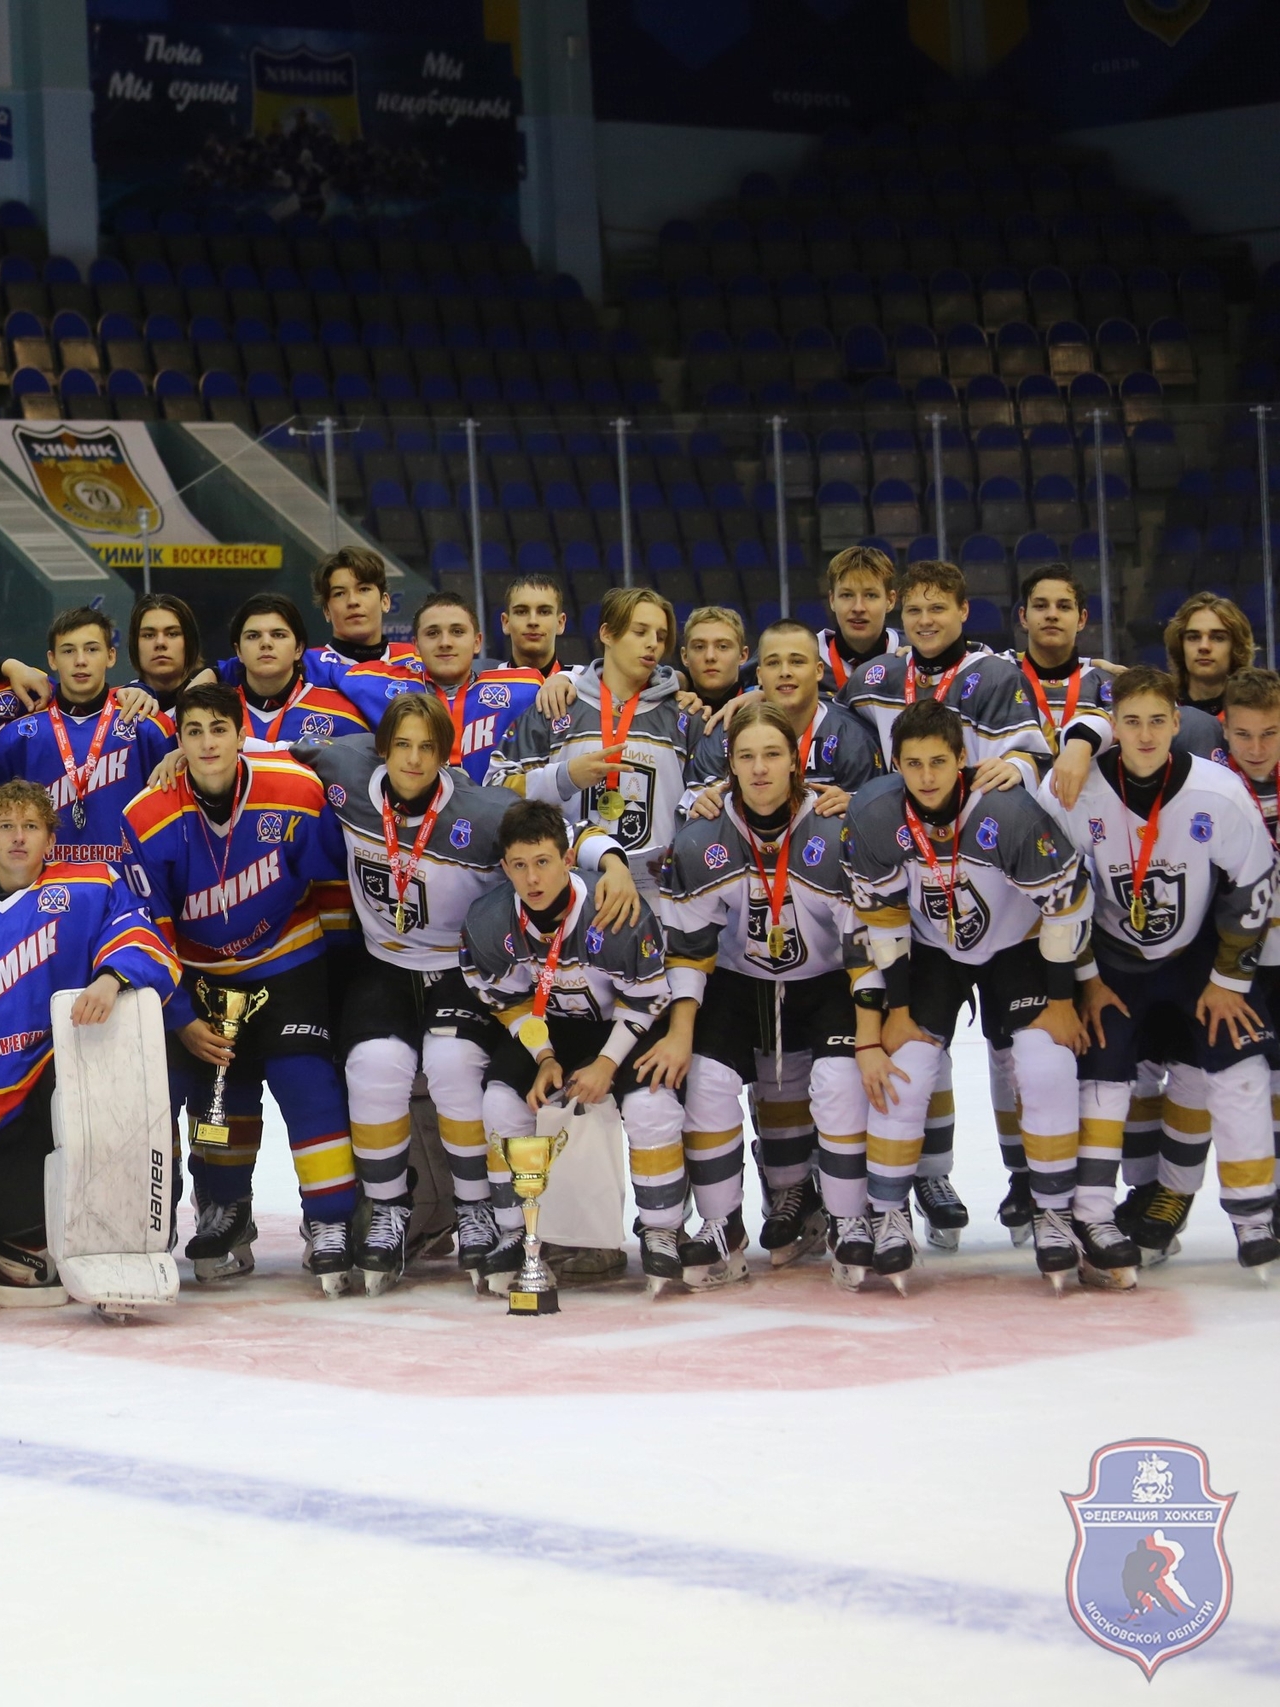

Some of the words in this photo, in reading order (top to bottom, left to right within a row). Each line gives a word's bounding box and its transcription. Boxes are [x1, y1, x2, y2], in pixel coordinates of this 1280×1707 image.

[144, 33, 203, 66] Пока
[421, 50, 465, 80] Мы
[263, 67, 349, 87] ХИМИК
[107, 71, 154, 100] Мы
[167, 77, 239, 112] едины
[374, 89, 512, 127] непобедимы
[29, 442, 118, 458] ХИМИК
[171, 545, 268, 566] ВОСКРЕСЕНСК
[382, 622, 413, 635] ЕКТОР
[44, 844, 123, 862] СКРЕСЕНСК
[1009, 995, 1048, 1012] BAU
[435, 1008, 491, 1026] CCM
[281, 1023, 330, 1040] BAUE
[826, 1035, 857, 1046] CC
[149, 1148, 163, 1233] BAUER
